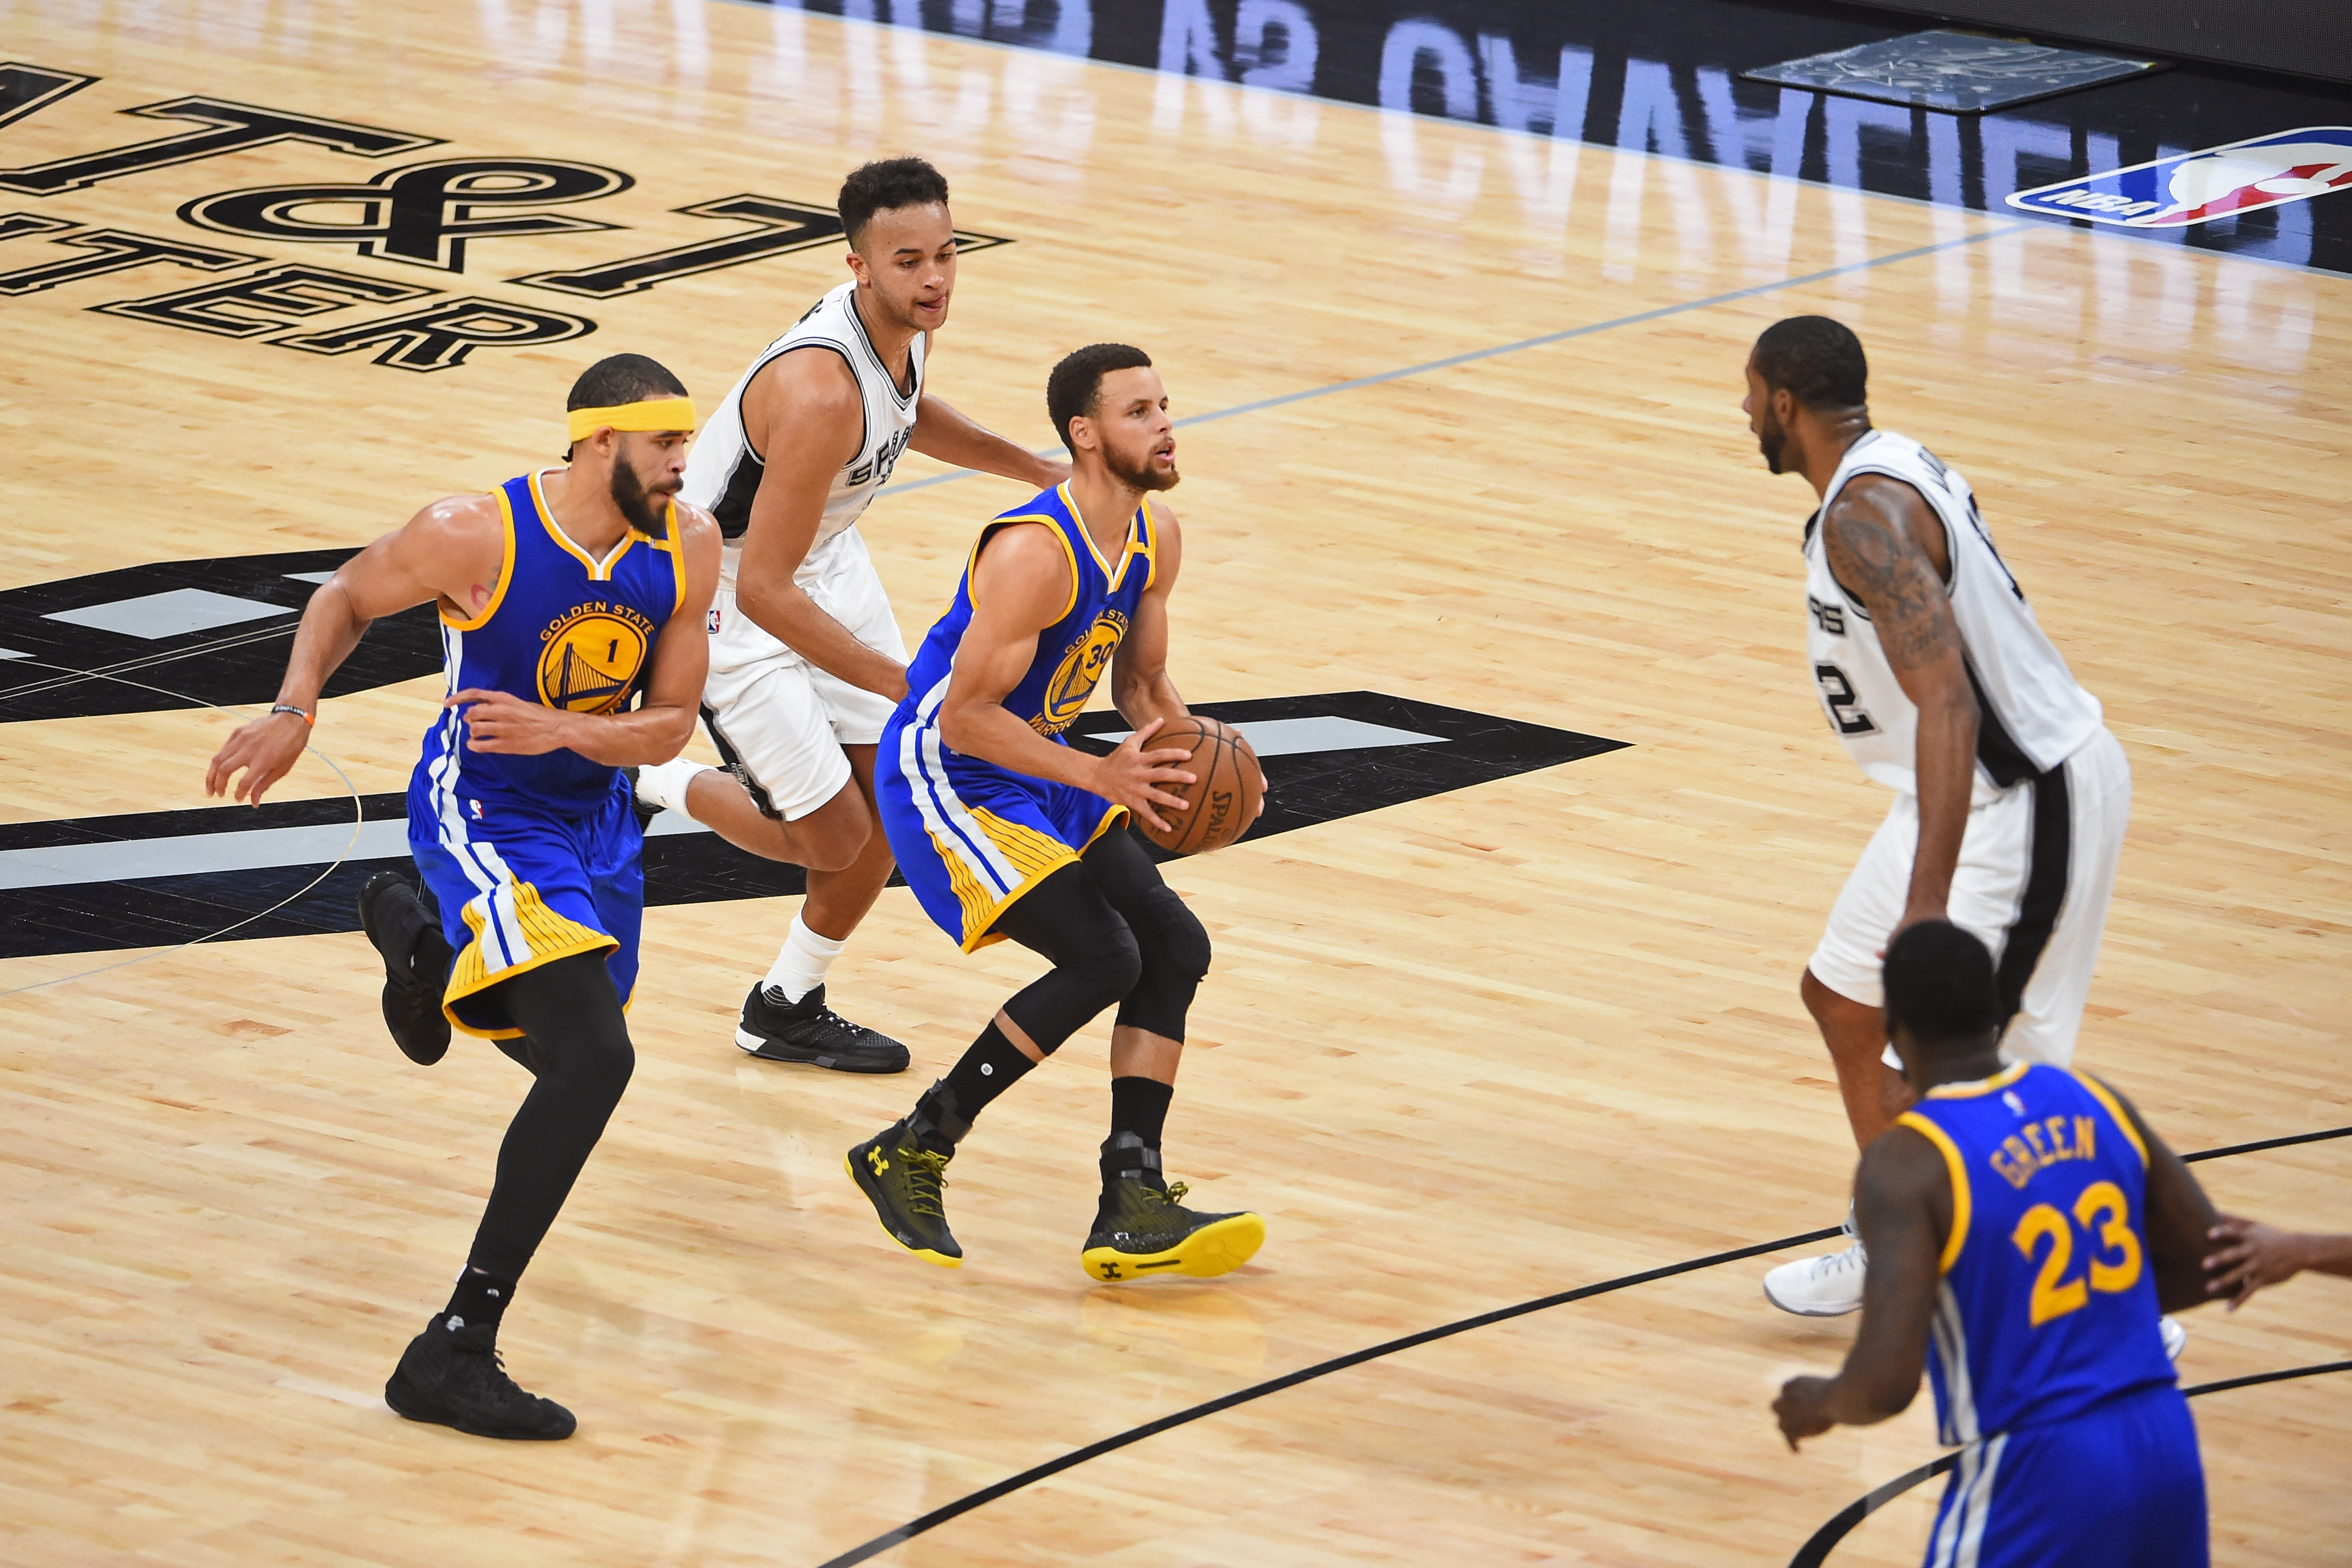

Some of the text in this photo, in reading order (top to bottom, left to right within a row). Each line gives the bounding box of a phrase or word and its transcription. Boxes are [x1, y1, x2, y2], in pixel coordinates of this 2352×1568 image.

[2038, 189, 2161, 216] NBA
[539, 601, 655, 641] GOLDEN STATE
[608, 638, 619, 663] 1
[1086, 641, 1115, 669] 30
[1815, 661, 1881, 737] 2
[1990, 1115, 2096, 1189] GREEN
[2010, 1180, 2143, 1328] 23
